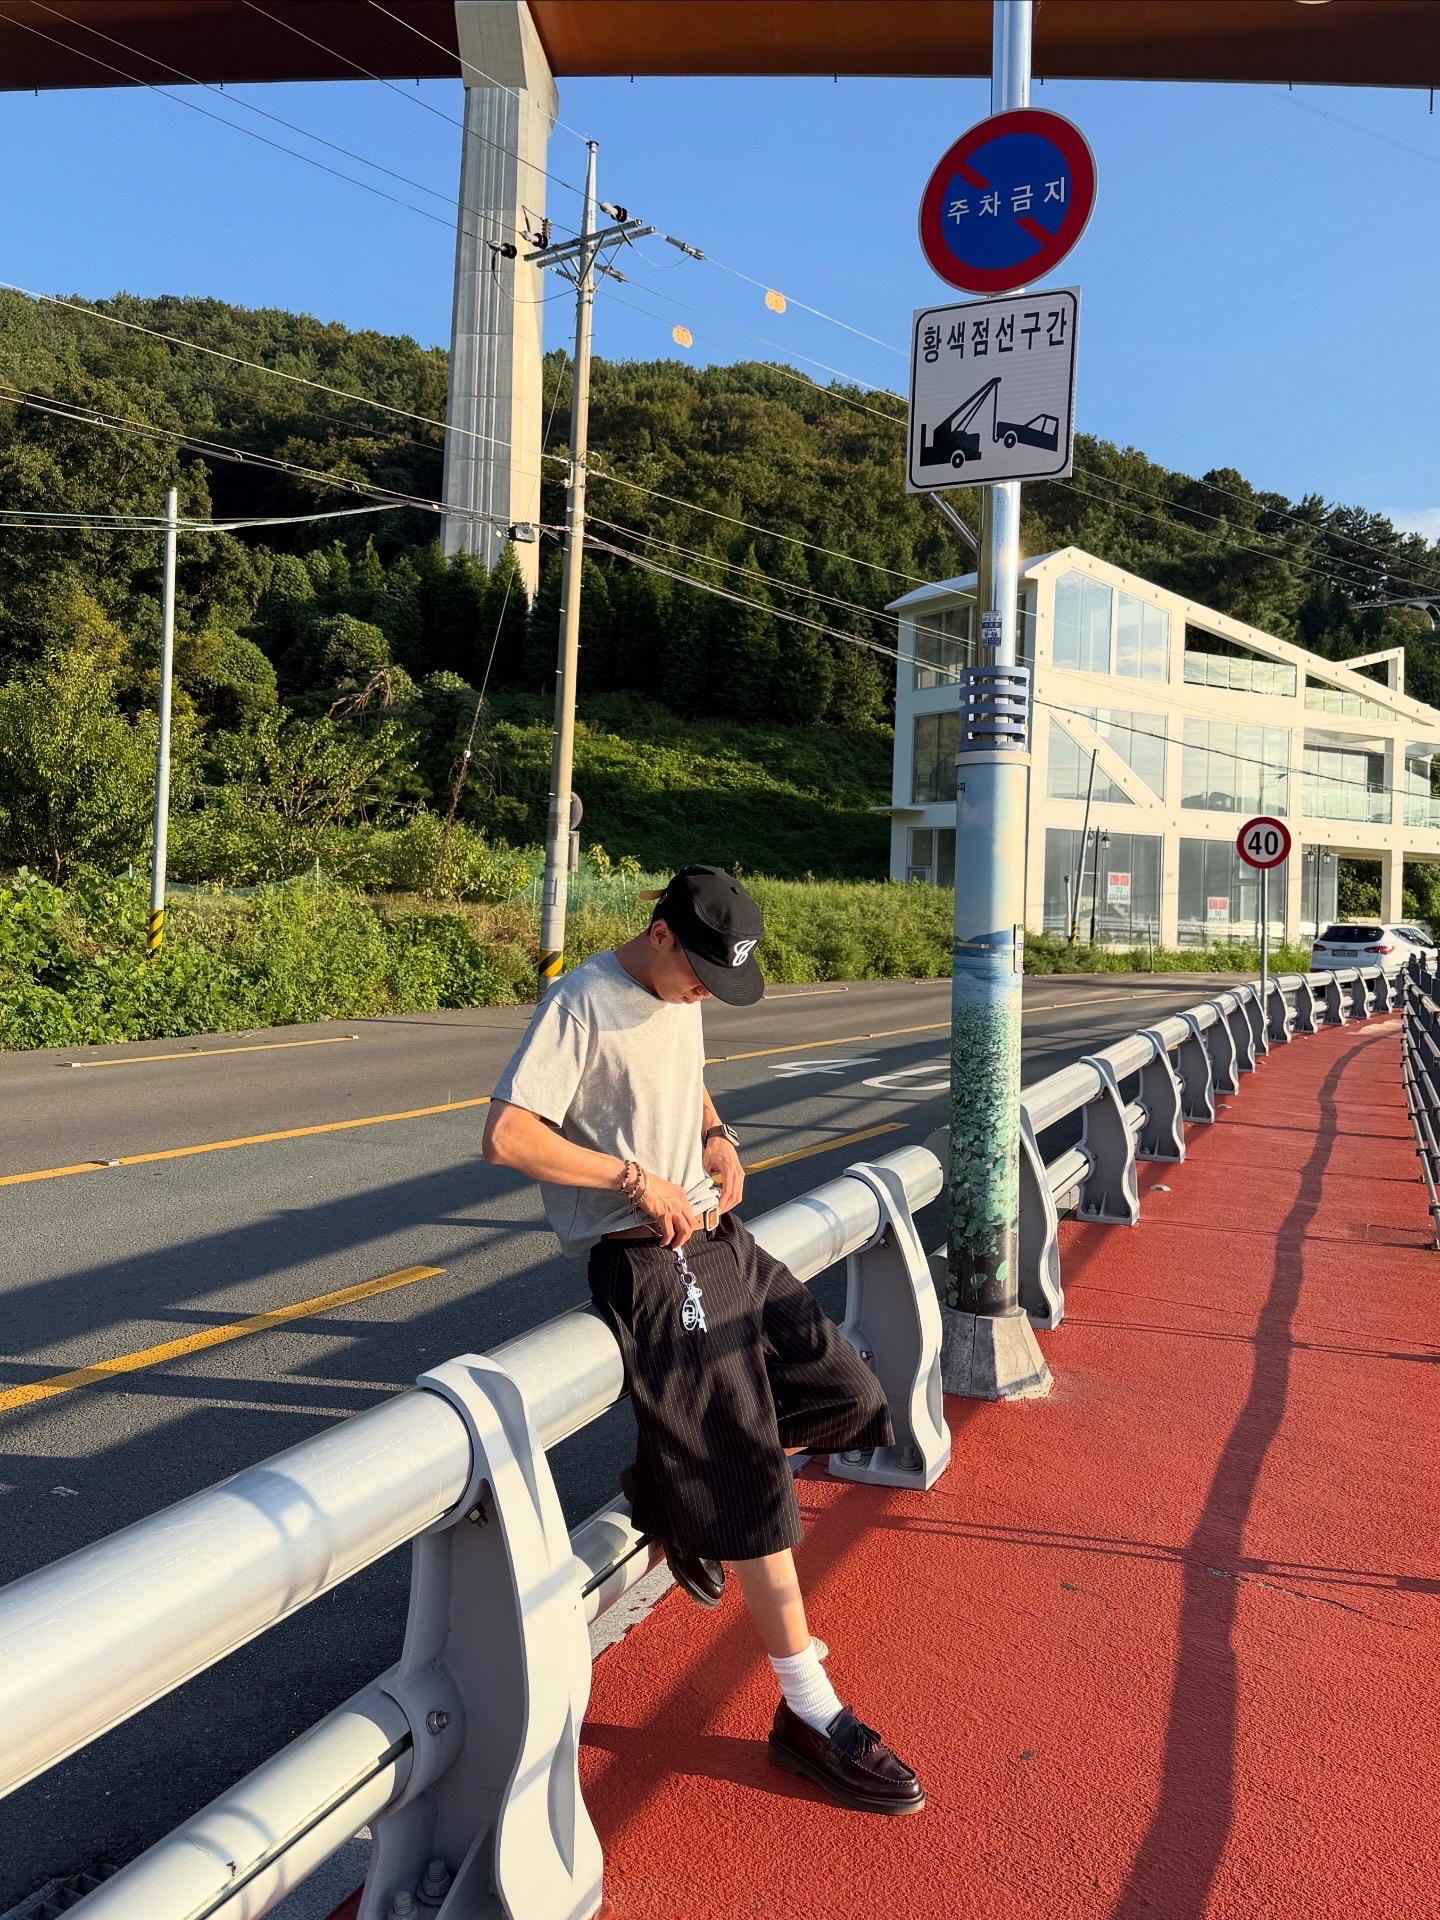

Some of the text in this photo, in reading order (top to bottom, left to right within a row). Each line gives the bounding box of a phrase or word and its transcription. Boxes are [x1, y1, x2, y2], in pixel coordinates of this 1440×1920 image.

[947, 176, 1066, 225] 주차금지
[923, 308, 1067, 363] 황색점선구간
[1248, 831, 1278, 855] 40
